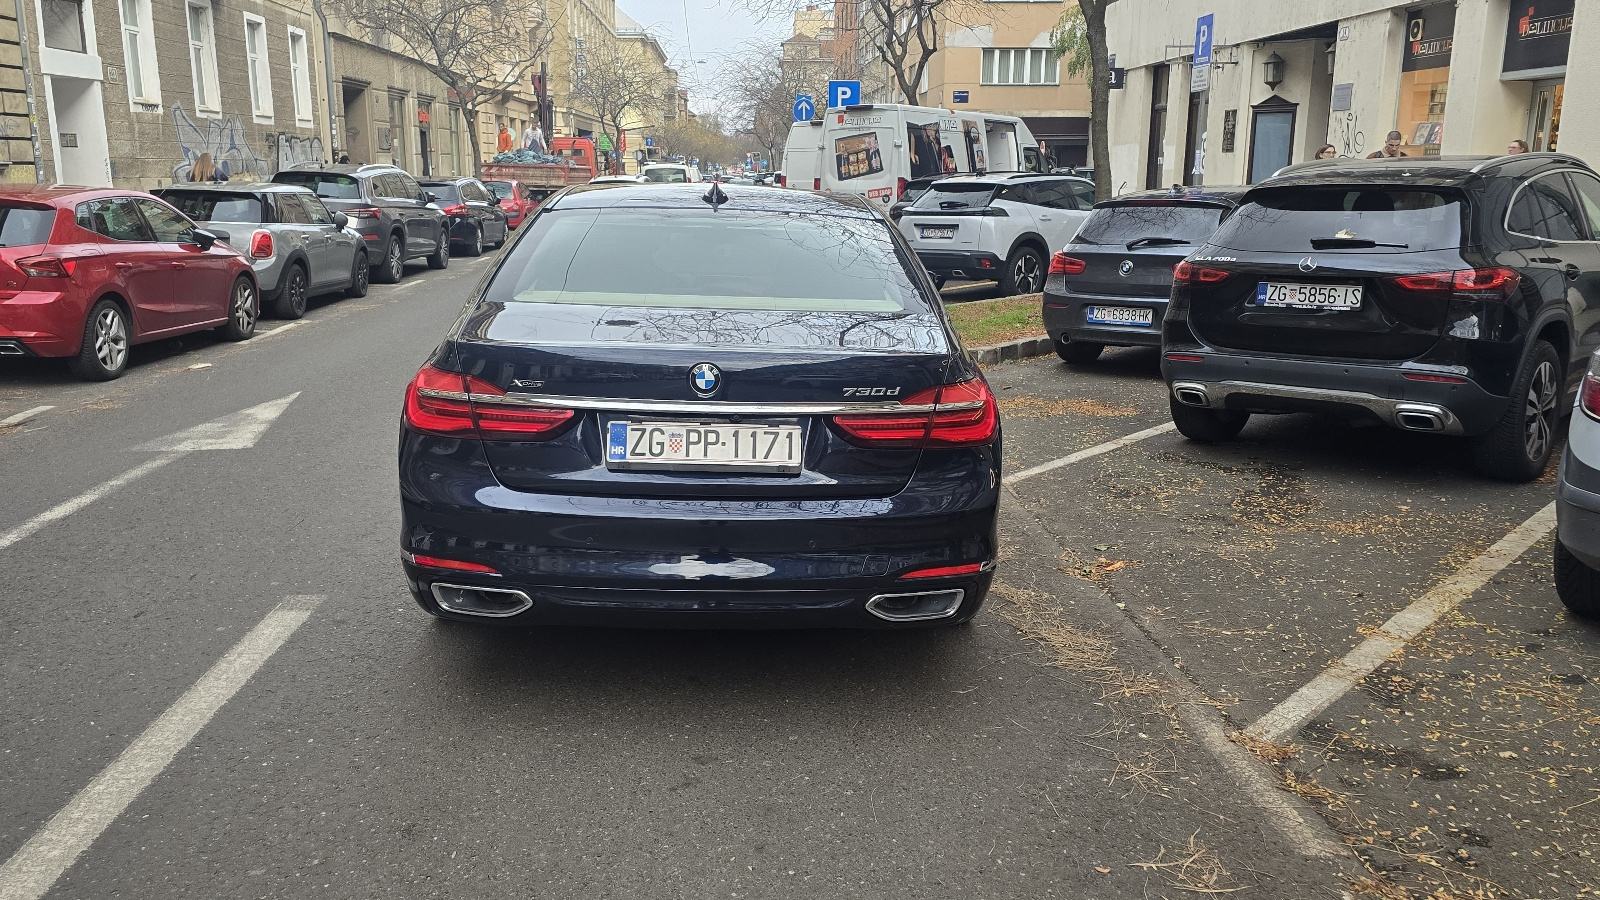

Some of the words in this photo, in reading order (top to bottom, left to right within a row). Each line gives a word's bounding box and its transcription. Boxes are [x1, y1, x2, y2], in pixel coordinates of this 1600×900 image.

[1199, 25, 1207, 55] P
[837, 86, 851, 107] P
[1268, 285, 1288, 301] ZG
[1094, 307, 1107, 320] ZG
[842, 386, 901, 397] 730d
[611, 446, 625, 455] HR
[630, 427, 665, 458] ZG
